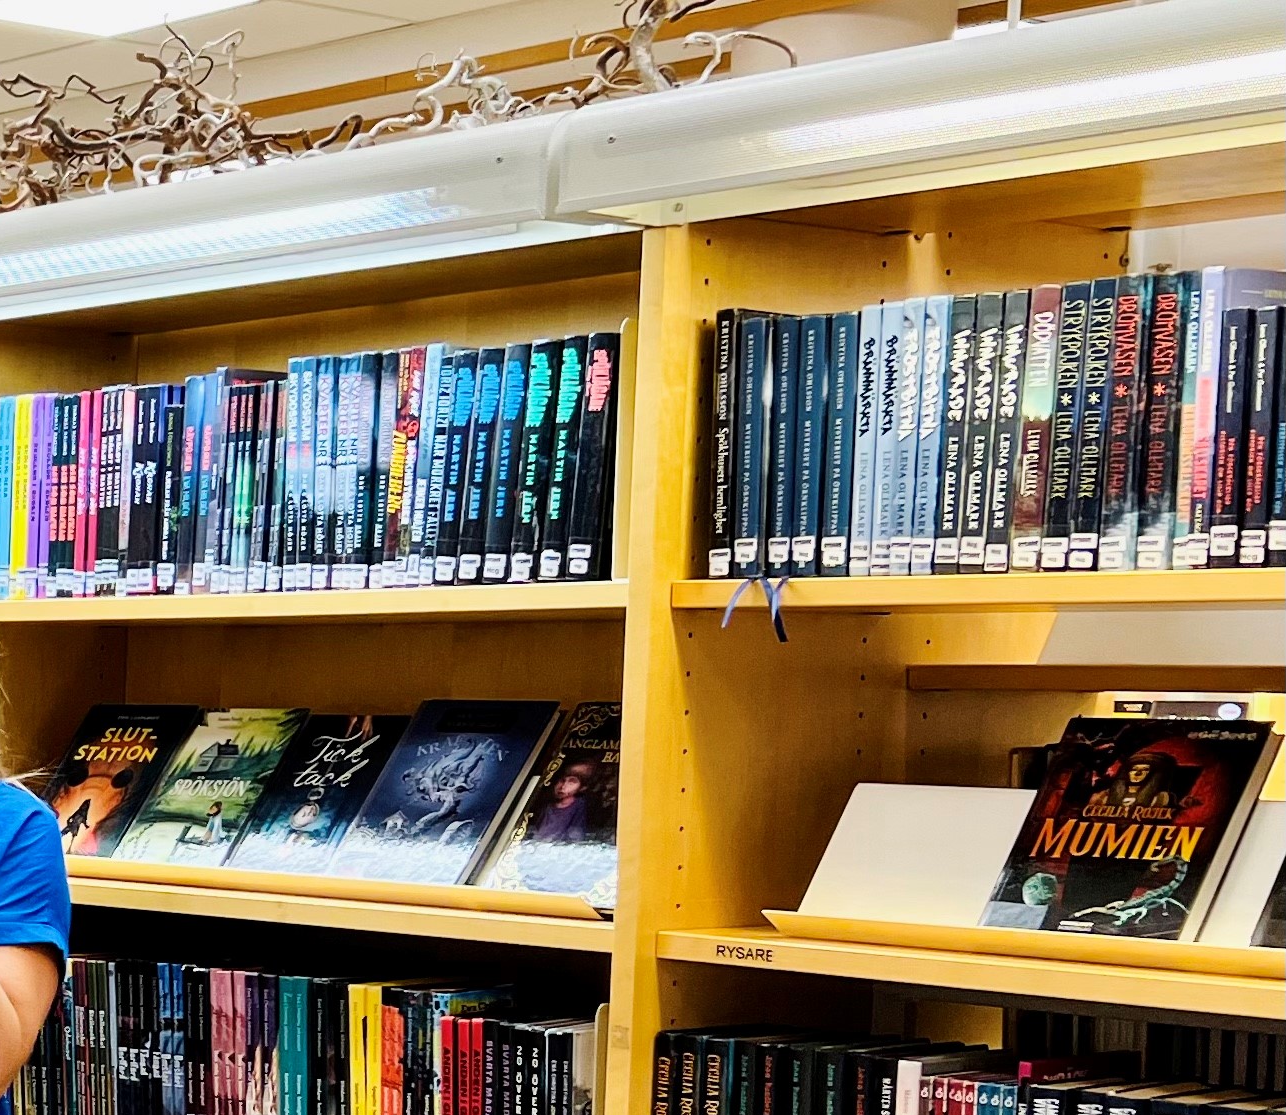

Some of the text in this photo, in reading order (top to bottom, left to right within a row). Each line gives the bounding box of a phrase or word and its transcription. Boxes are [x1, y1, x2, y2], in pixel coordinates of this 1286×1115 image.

[1028, 311, 1055, 387] DÖDVATTEN
[1113, 295, 1138, 376] DRÖMVÄSEN
[1151, 293, 1177, 375] DRÖMVÄSEN
[288, 372, 300, 443] SKYDDSRUM
[301, 370, 314, 442] SKYDDSRUM
[317, 377, 330, 436] KVARTER
[801, 329, 816, 480] KRISTINA OHLSSON MYSTERIET PÅ
[832, 326, 847, 479] KRISTINA OHLSSON MYSTERIET PÅ
[1050, 300, 1081, 499] STRYKPOJKEN LENA OLLMARK
[1078, 298, 1113, 499] STRYKPOJKEN LENA OLLMARK
[316, 439, 328, 457] NR
[714, 320, 731, 535] KRISTINA OHLSSON Spökhusets hemlighet
[448, 434, 462, 485] MARTIN
[472, 431, 487, 483] MARTIN
[495, 429, 511, 518] MARTIN JERN
[524, 434, 539, 486] MARTIN
[553, 429, 568, 482] MARTIN
[992, 433, 1010, 528] LENA OLLMARK
[520, 490, 533, 523] JERN
[549, 487, 562, 520] JERN
[942, 437, 959, 530] LENA OLLMARK
[73, 743, 159, 764] STATION
[100, 727, 158, 744] SLUT-
[309, 733, 381, 764] Tick
[170, 775, 251, 800] SPÖKSJÖN
[292, 757, 370, 789] tack
[1082, 805, 1130, 819] CECILIA
[1030, 818, 1205, 862] MUMIEN
[716, 945, 774, 962] RYSARE
[484, 1041, 493, 1083] SVARTA
[502, 1044, 511, 1087] SVARTA
[656, 1057, 670, 1098] CECILIA
[681, 1052, 694, 1094] CECILIA
[706, 1054, 720, 1096] CECILIA
